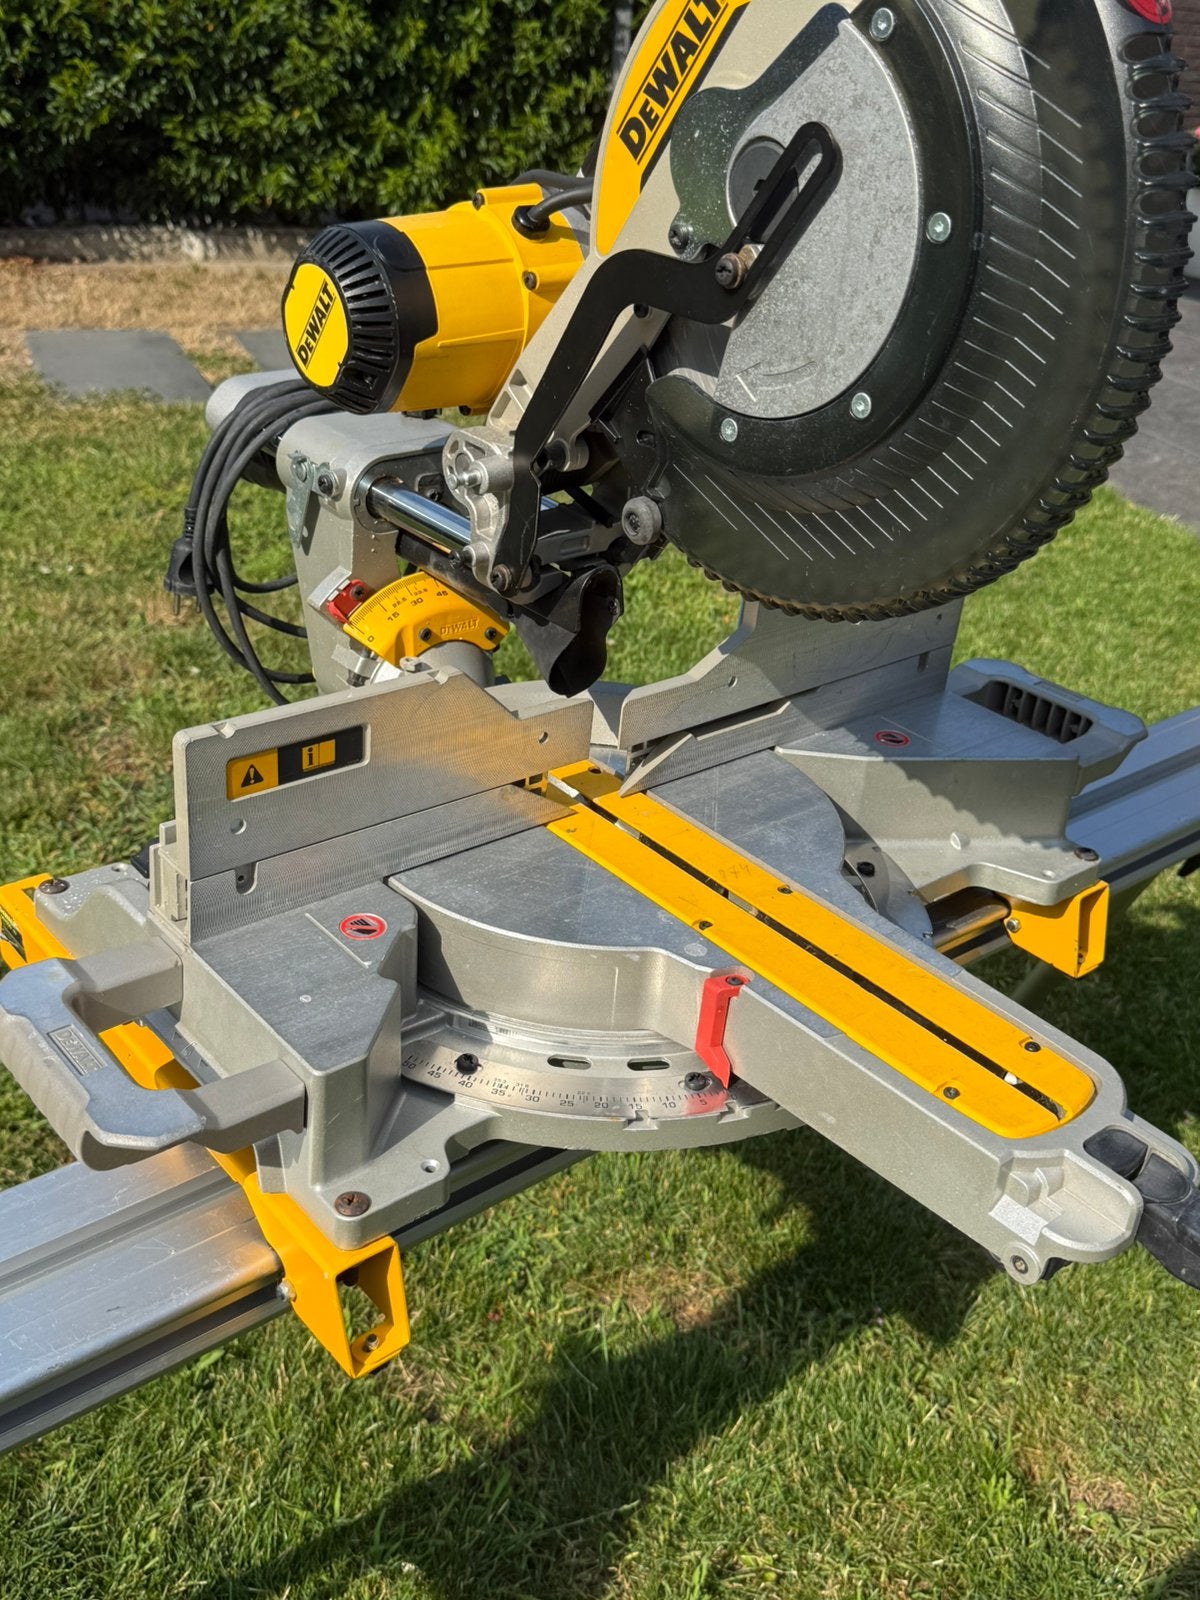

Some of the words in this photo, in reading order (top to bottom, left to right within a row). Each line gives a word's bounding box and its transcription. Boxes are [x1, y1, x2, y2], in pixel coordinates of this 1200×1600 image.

[367, 635, 375, 643] 0
[387, 611, 400, 621] 15
[410, 597, 423, 606] 30
[401, 1060, 416, 1070] 50
[427, 1069, 442, 1079] 45
[458, 1080, 473, 1089] 40
[491, 1088, 506, 1097] 35
[525, 1094, 540, 1103] 30
[560, 1099, 574, 1107] 25
[663, 1101, 677, 1109] 10
